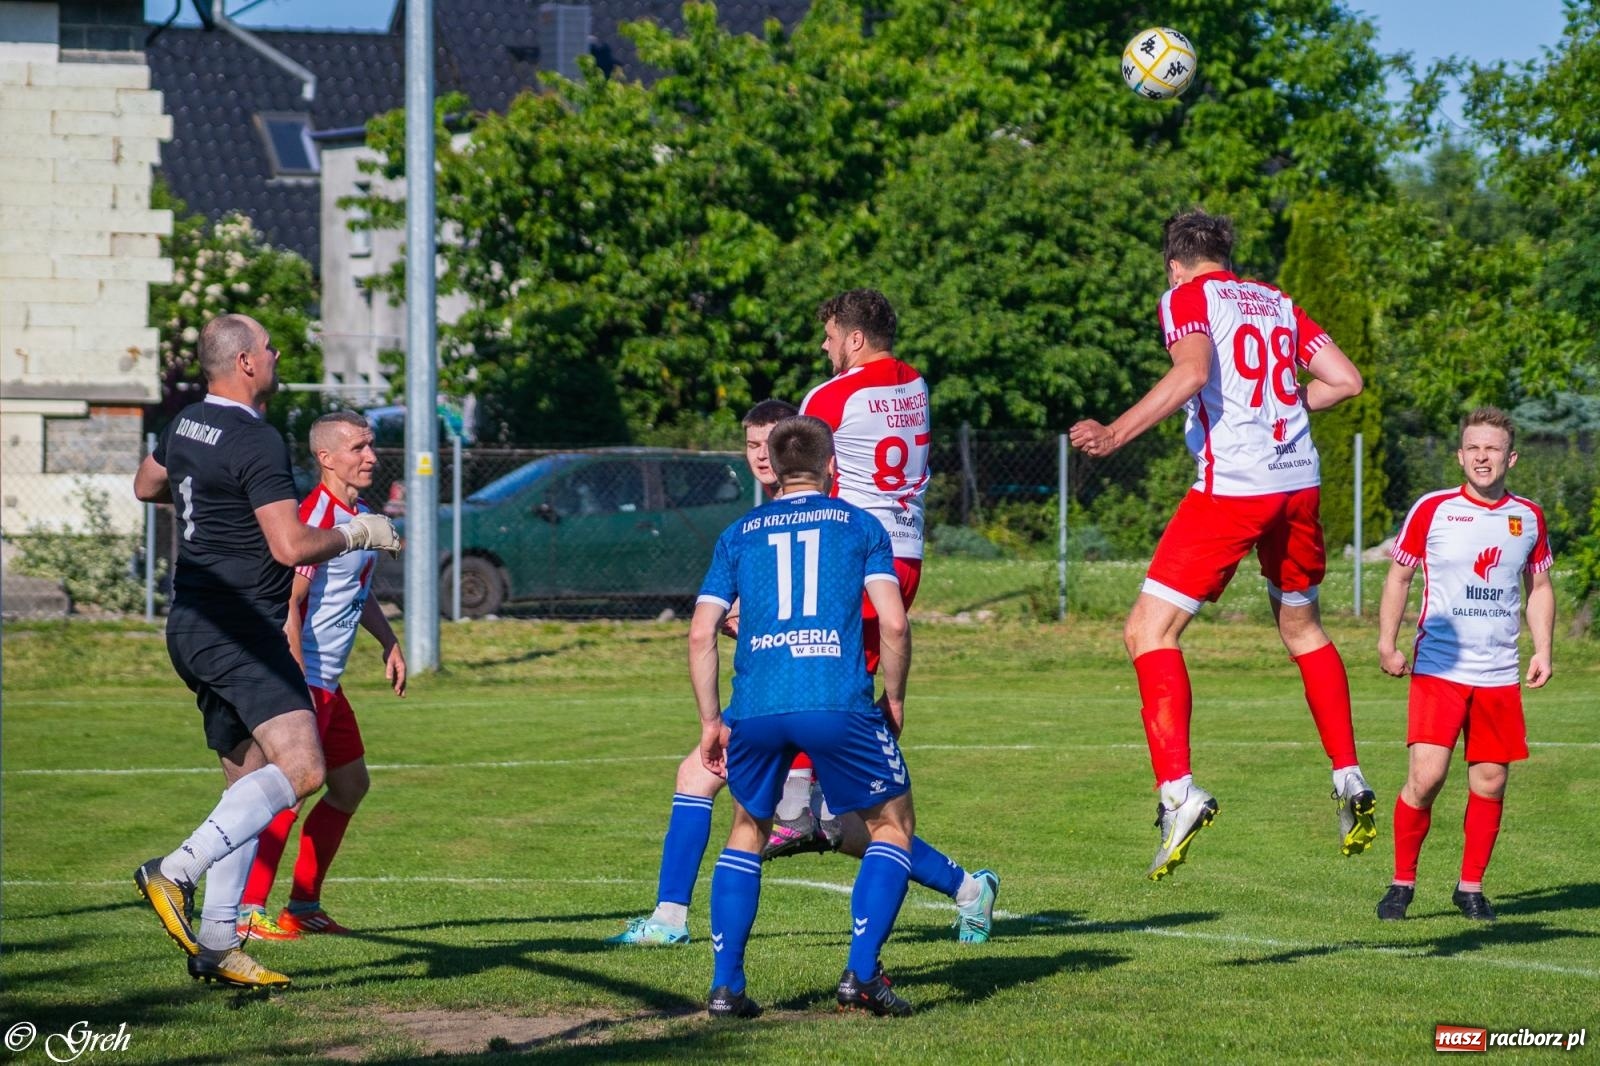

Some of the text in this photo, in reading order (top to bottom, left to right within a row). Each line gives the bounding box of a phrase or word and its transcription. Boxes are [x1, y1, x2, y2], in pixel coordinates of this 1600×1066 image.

[1217, 288, 1238, 301] LKS
[1233, 323, 1298, 407] 98
[868, 392, 928, 414] LKS ZAMECZE
[886, 412, 926, 428] CZERNICA
[874, 433, 931, 492] 87
[178, 475, 195, 541] 1
[742, 508, 850, 535] LKS KRZYŻANOWICE
[767, 528, 821, 620] 11
[1465, 584, 1504, 601] Husar
[1452, 607, 1488, 617] GALERIA
[750, 629, 840, 653] DROGERIA
[809, 646, 838, 654] SIECI
